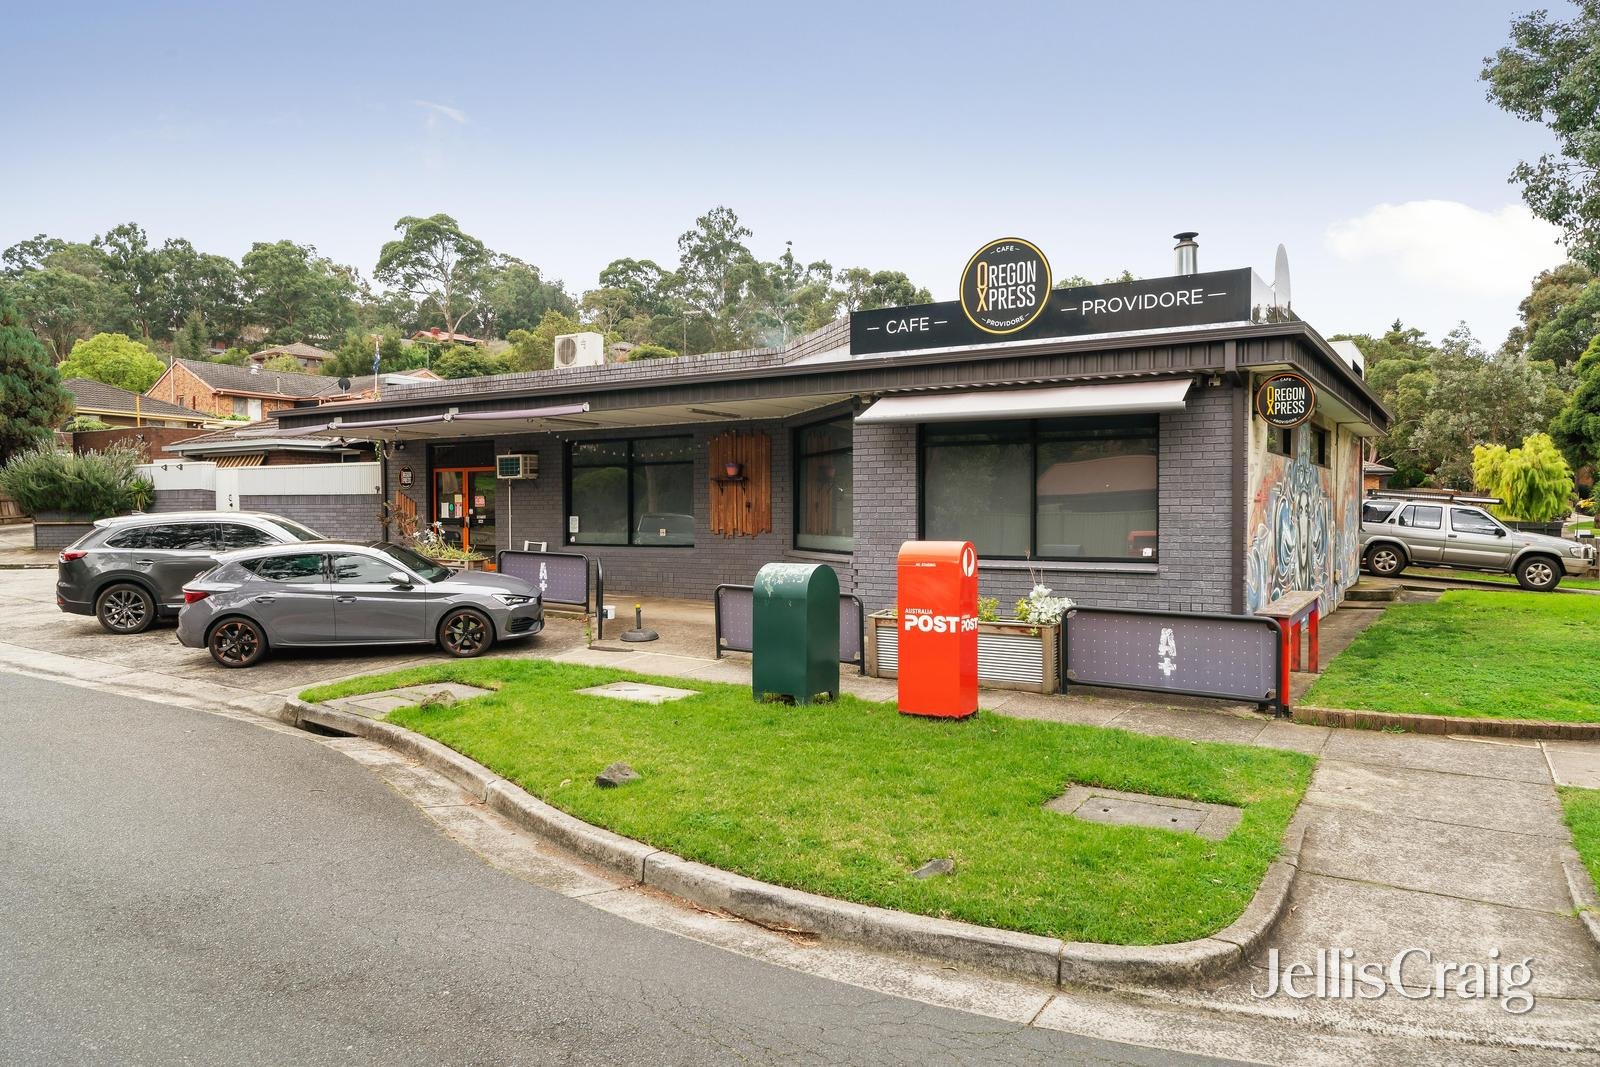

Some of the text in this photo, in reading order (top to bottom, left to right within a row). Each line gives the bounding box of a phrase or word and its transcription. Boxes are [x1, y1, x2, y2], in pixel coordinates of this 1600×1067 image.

[996, 245, 1014, 253] CAFE
[977, 260, 1037, 288] OREGON
[976, 284, 1036, 312] XPRESS
[1082, 288, 1204, 315] PROVIDORE
[886, 316, 930, 335] CAFE
[986, 315, 1025, 327] PROVIDORE
[1266, 386, 1305, 402] OREGON
[1266, 400, 1305, 415] XPRESS
[904, 614, 960, 633] POST
[961, 617, 978, 632] POST
